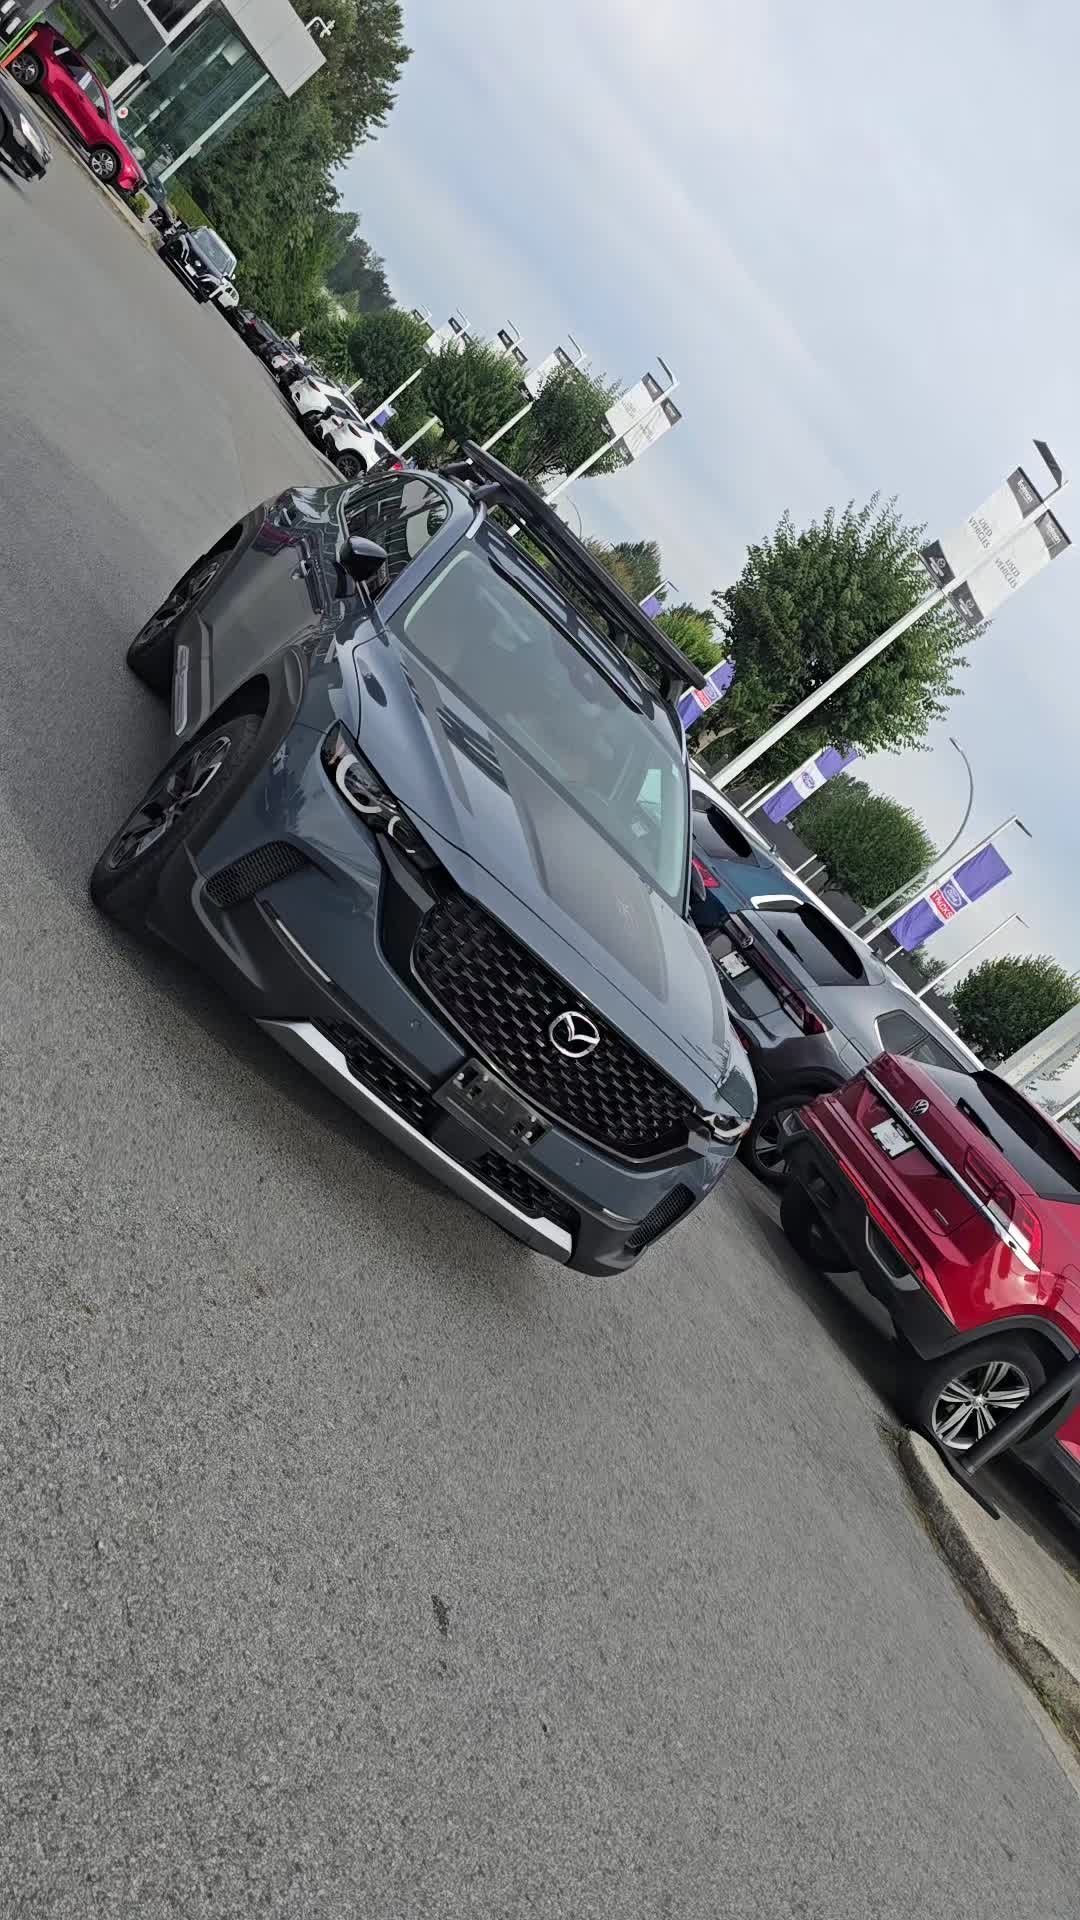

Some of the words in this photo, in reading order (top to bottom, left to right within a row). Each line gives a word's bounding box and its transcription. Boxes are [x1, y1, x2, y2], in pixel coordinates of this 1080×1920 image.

[968, 516, 991, 549] VEHICLES
[978, 518, 993, 537] USED
[994, 558, 1018, 589] VEHICLES
[1005, 559, 1020, 578] USED
